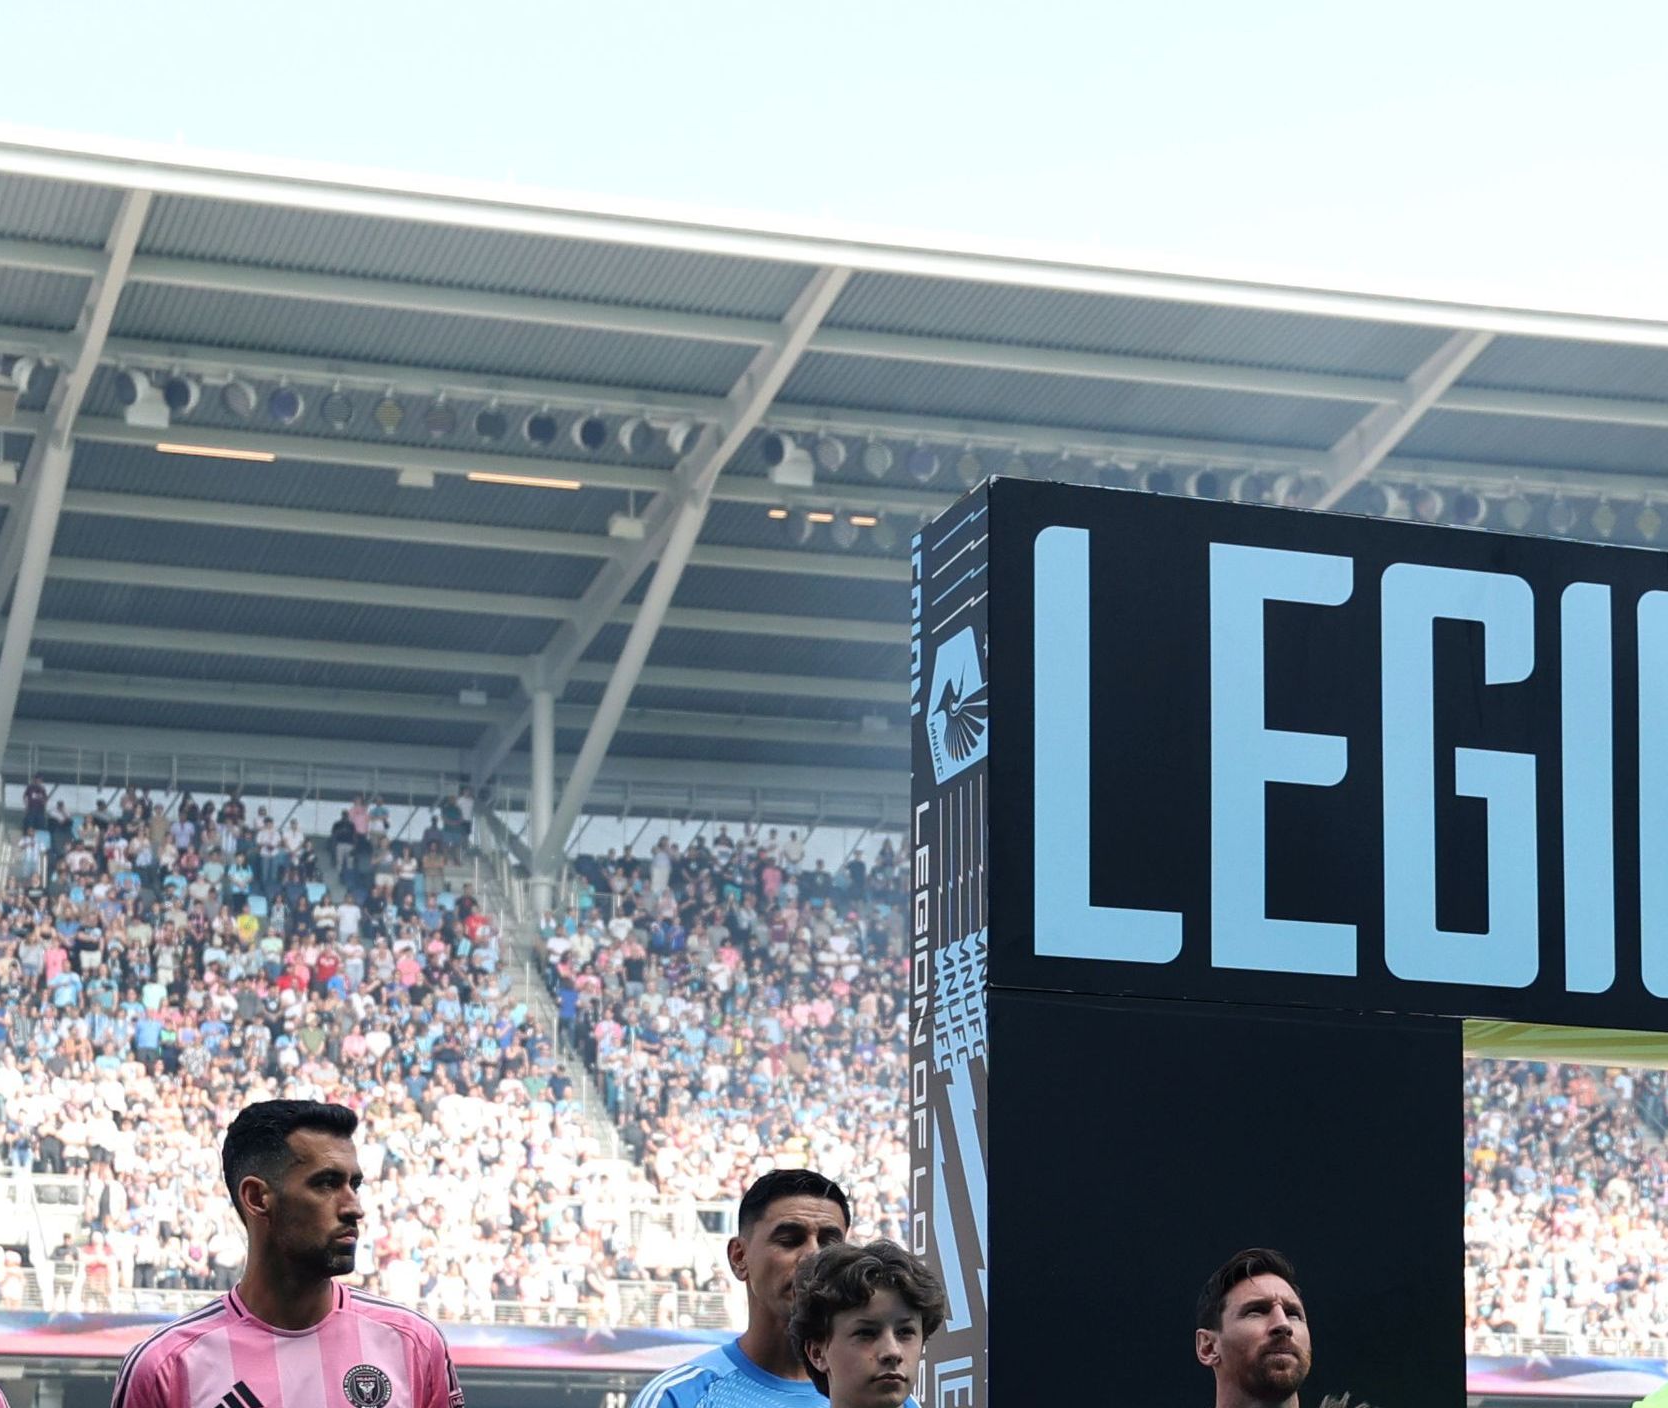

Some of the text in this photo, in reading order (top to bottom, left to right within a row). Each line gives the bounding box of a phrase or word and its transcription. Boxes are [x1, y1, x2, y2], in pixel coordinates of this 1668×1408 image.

[928, 722, 944, 777] MNUFC
[913, 800, 930, 1047] LEGION
[912, 1060, 928, 1150] OF
